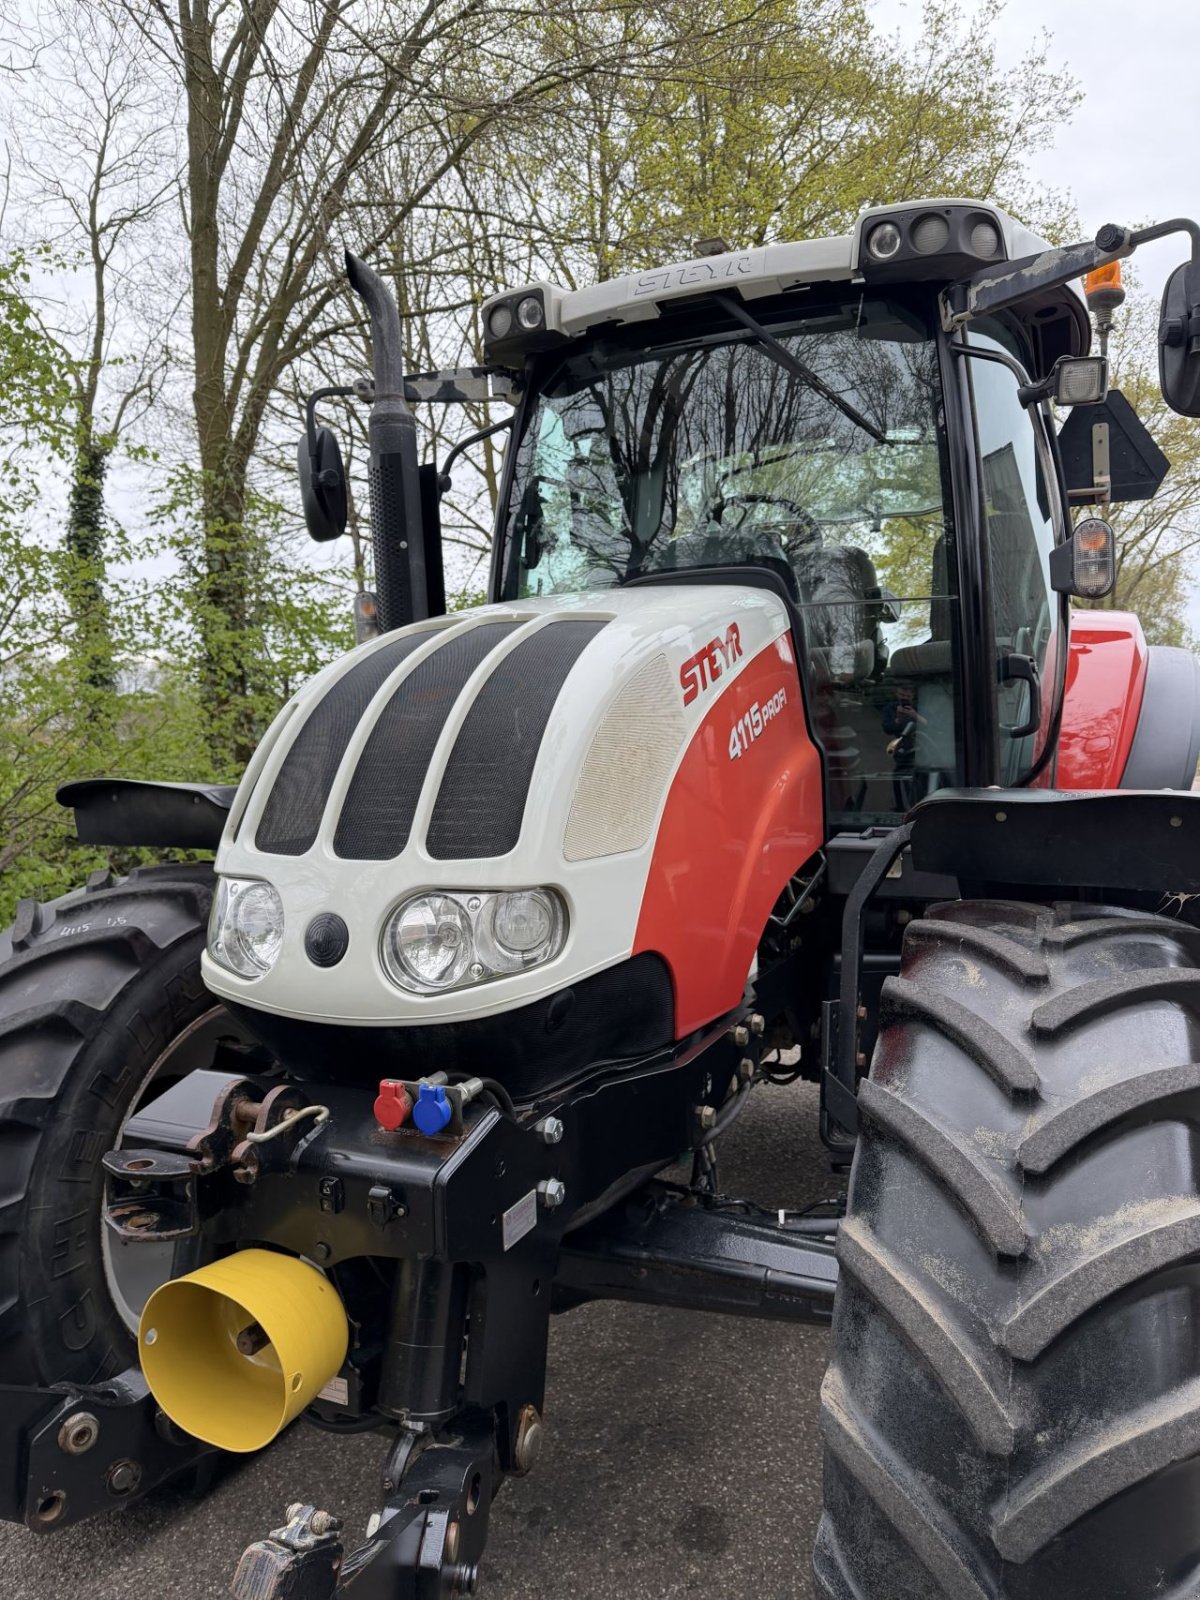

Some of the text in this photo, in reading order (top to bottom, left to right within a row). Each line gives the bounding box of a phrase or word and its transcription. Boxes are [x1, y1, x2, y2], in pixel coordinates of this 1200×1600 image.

[634, 256, 753, 296] STEYR
[679, 621, 743, 708] STEYR
[728, 687, 788, 761] 4115 PROFI
[51, 958, 206, 1386] ICHELIN
